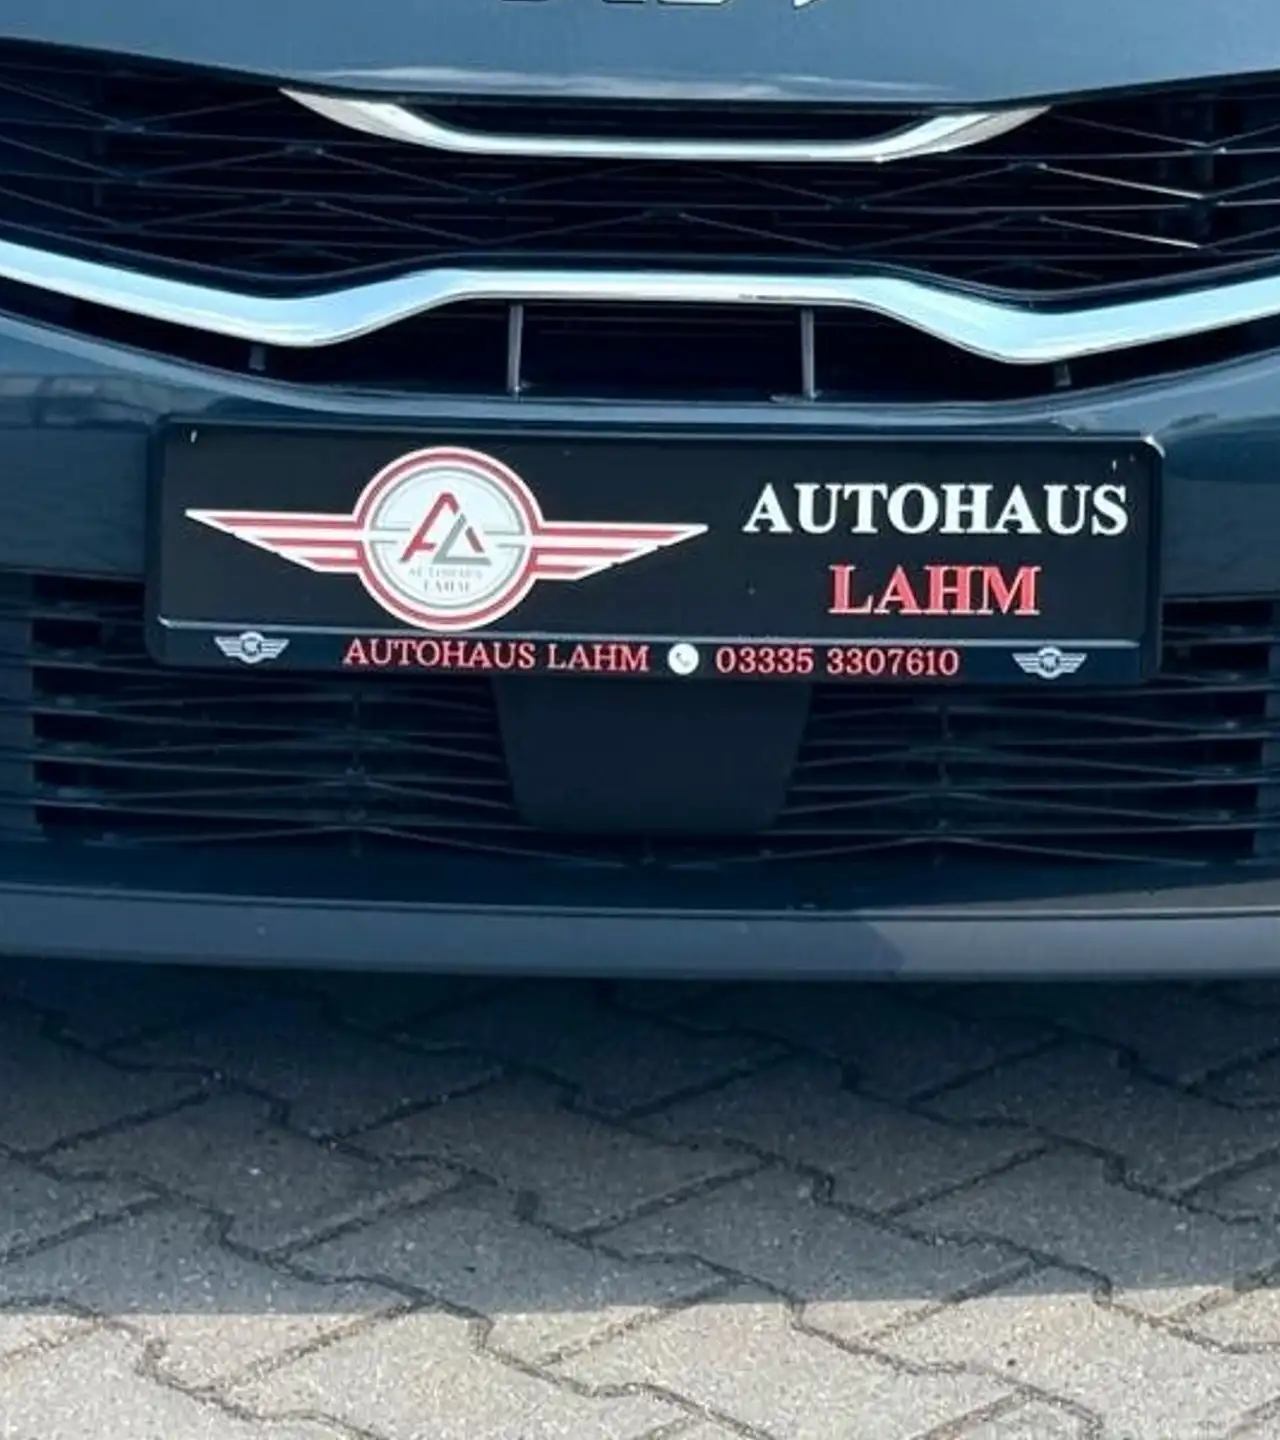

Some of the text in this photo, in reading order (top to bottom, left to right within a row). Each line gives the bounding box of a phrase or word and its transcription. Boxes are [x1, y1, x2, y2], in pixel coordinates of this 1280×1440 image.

[743, 482, 1128, 536] AUTOHAUS
[828, 564, 1041, 615] LAHM
[343, 638, 961, 676] AUTOHAUS LAHM 03335 3307610
